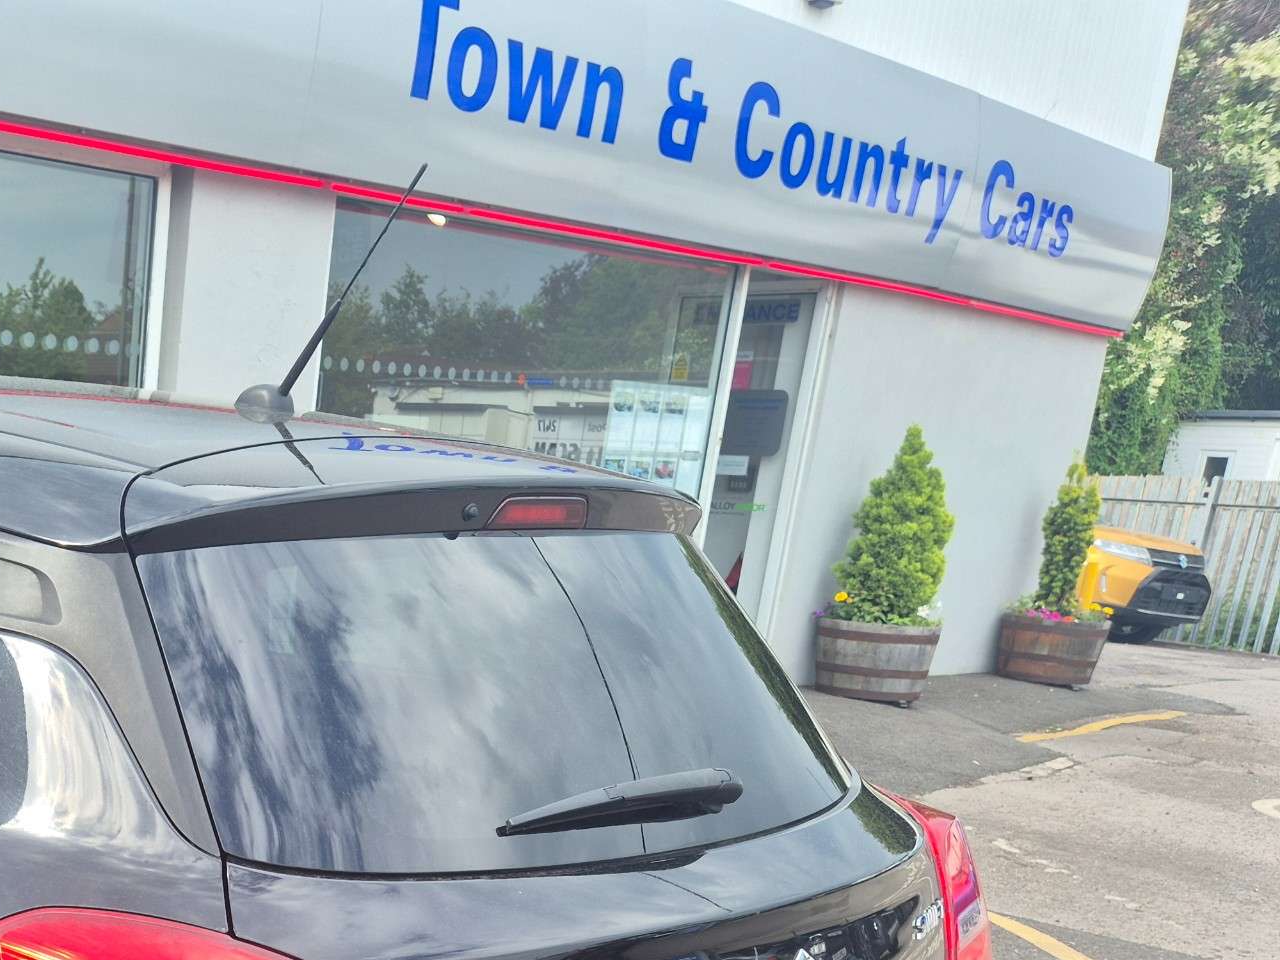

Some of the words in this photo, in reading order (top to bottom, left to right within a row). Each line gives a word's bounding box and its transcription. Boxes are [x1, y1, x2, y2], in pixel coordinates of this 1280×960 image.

[410, 0, 624, 144] Town
[657, 57, 708, 163] &
[735, 81, 963, 245] Country
[980, 160, 1074, 258] Cars
